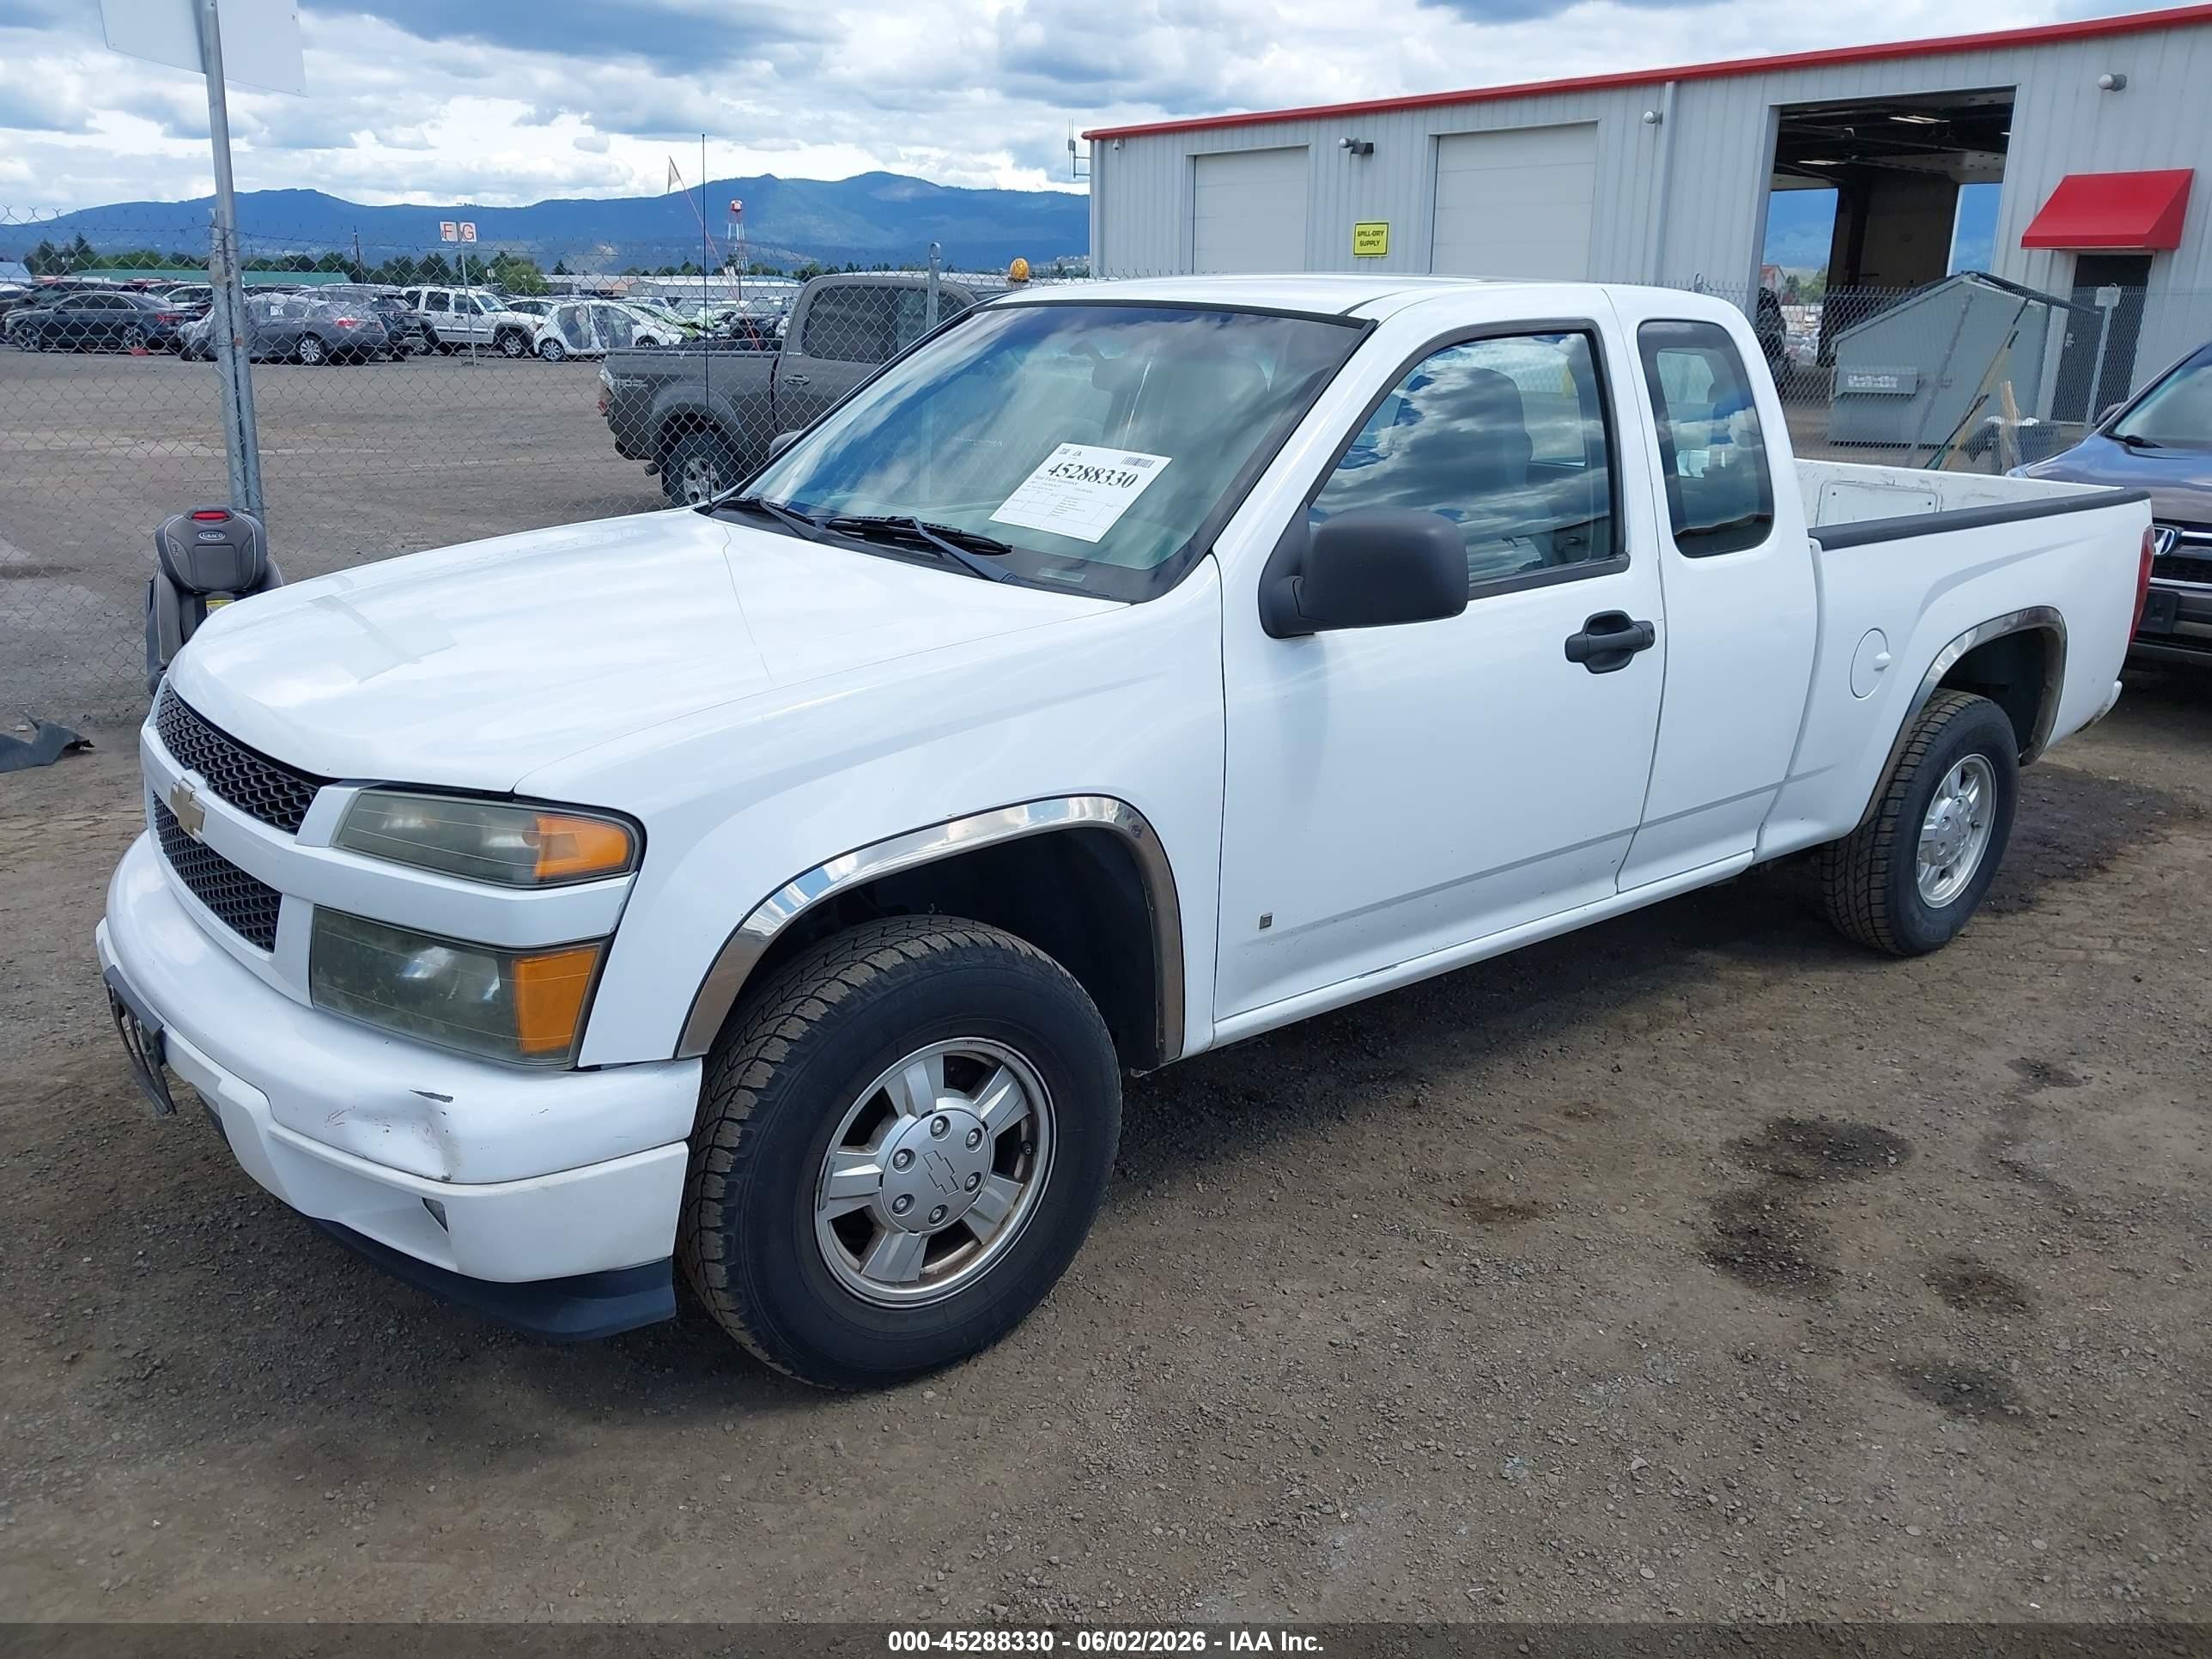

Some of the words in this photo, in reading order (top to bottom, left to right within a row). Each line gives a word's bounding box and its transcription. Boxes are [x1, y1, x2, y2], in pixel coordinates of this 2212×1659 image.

[443, 223, 453, 240] F
[462, 224, 474, 240] G
[1048, 462, 1139, 489] 45288330
